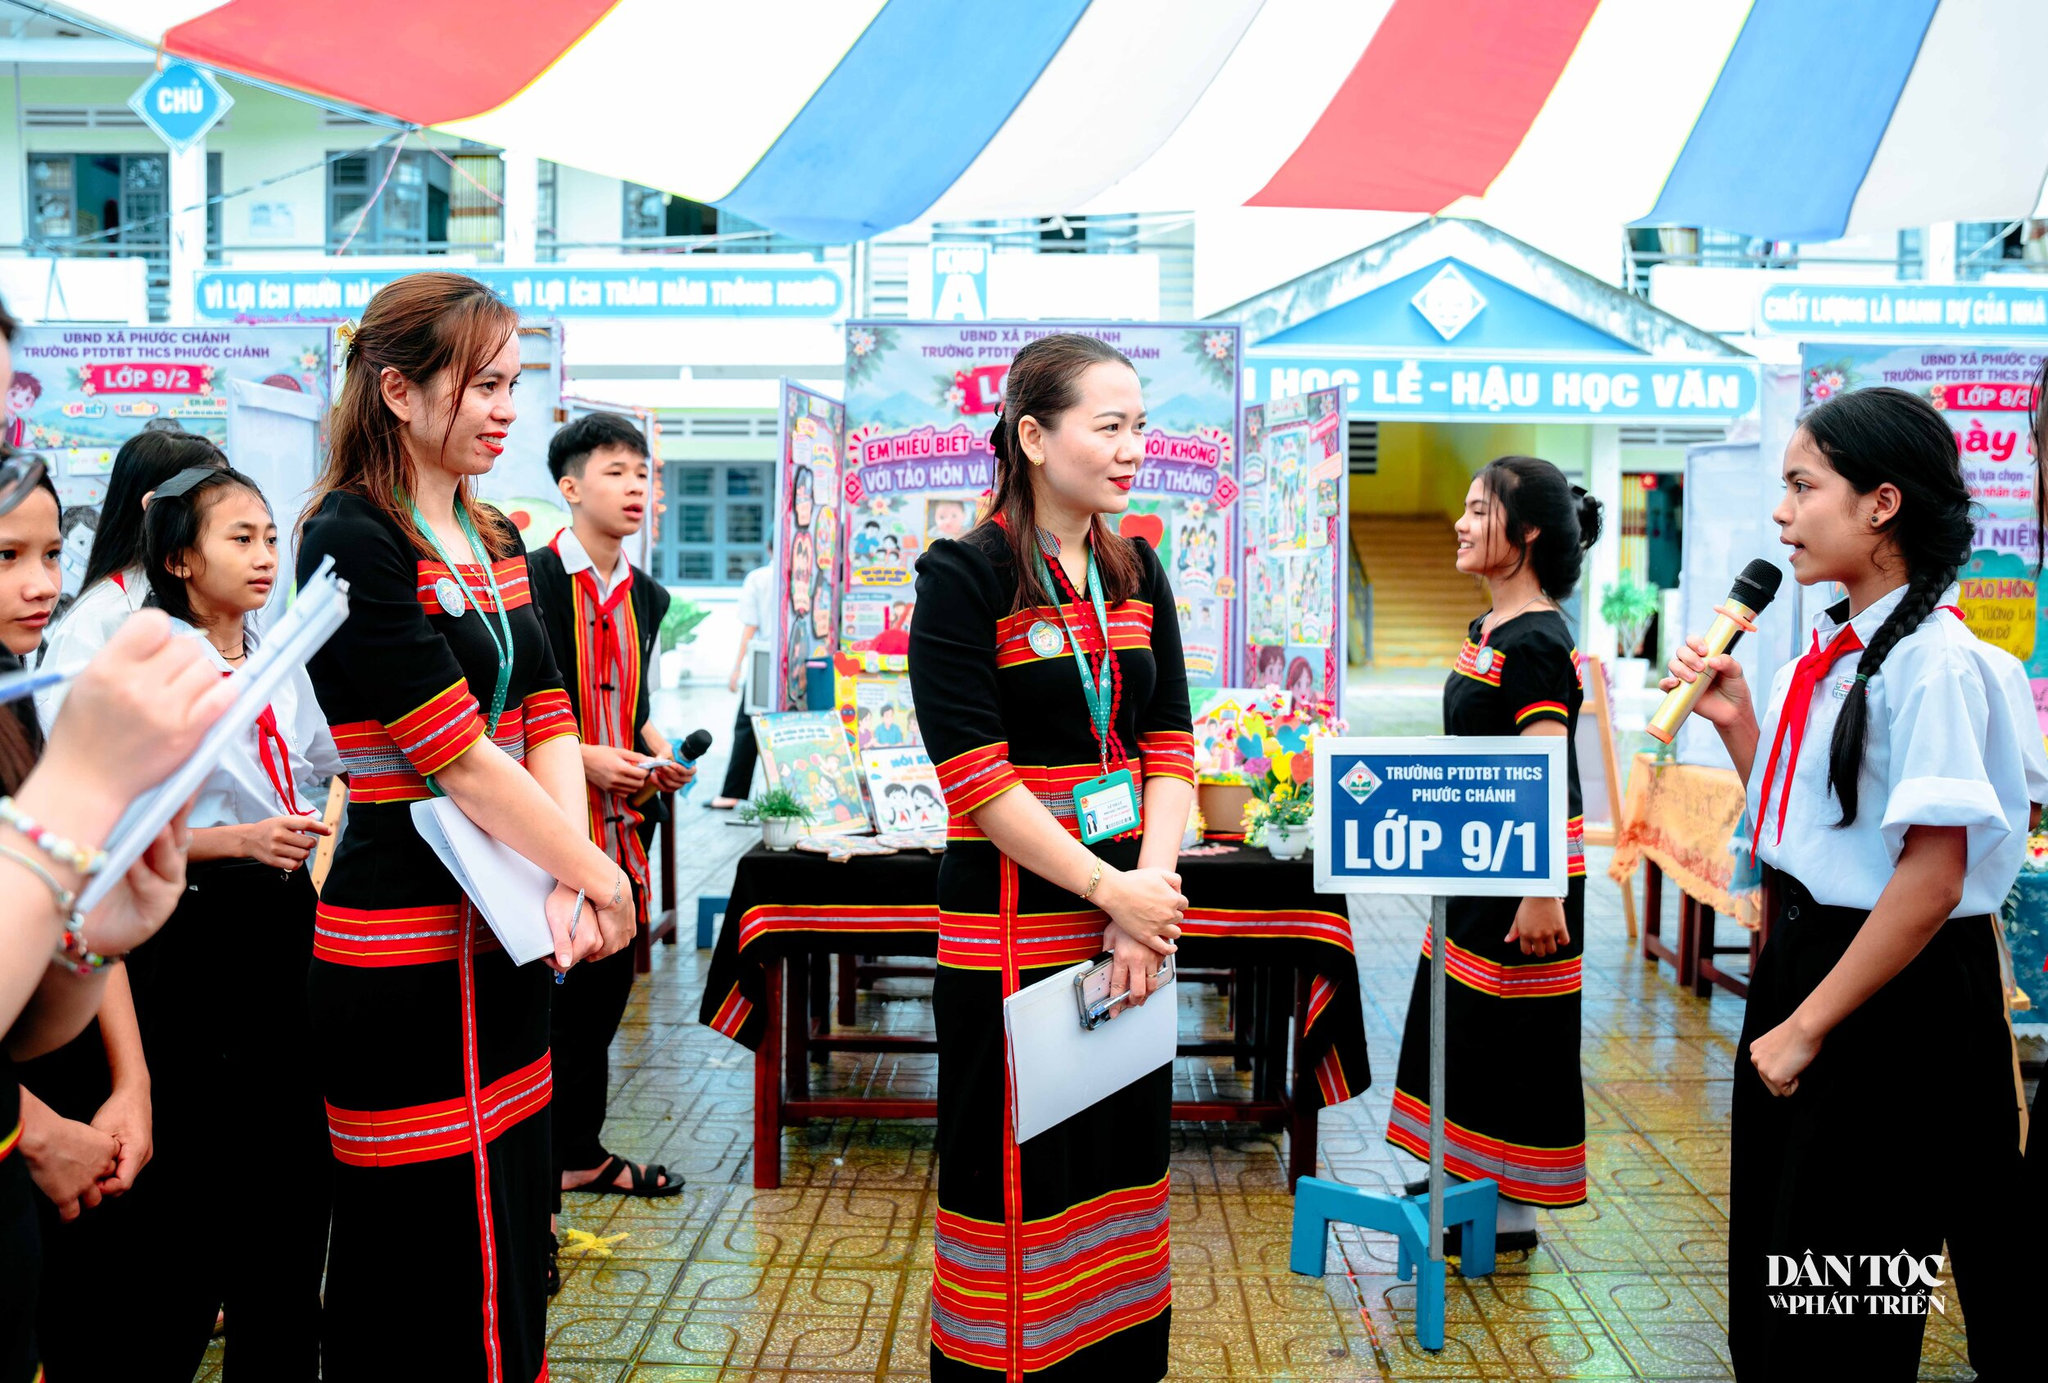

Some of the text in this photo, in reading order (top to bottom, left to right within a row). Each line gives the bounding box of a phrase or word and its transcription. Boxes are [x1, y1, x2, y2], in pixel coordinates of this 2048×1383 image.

[157, 78, 204, 115] CHỦ
[935, 274, 985, 320] A
[63, 330, 230, 344] UBND XÃ PHƯỚC CHÁNH
[960, 330, 997, 342] UBND
[1001, 328, 1020, 342] XÃ
[24, 344, 270, 359] TRƯỜNG PTDTBT THCS PHƯỚC CHÁNH
[921, 344, 974, 358] TRƯỜNG
[1921, 354, 1956, 366] UBND
[1959, 351, 1978, 366] XÃ
[1981, 351, 2025, 366] PHƯỚC
[104, 366, 190, 390] LỚP 9/2
[1883, 367, 1932, 382] TRƯỜNG
[1936, 370, 1983, 381] PTDTBT
[1988, 370, 2019, 381] THCS
[1451, 365, 1540, 411] HẬU
[1552, 372, 1640, 413] HỌC
[1652, 368, 1739, 408] VĂN
[1957, 385, 2031, 408] LỚP 8/3
[867, 442, 890, 462] EM
[896, 429, 930, 457] HIỂU
[935, 428, 969, 453] BIẾT
[1170, 438, 1216, 463] KHÔNG
[865, 466, 893, 493] VỚI
[895, 461, 926, 489] TẢO
[929, 460, 964, 487] HÔN
[967, 459, 989, 485] VÀ
[1165, 464, 1213, 495] THỐNG
[1385, 763, 1542, 780] TRƯỜNG PTDTBT THCS
[1412, 786, 1516, 803] PHƯỚC CHÁNH
[1344, 809, 1536, 872] LỚP 9/1
